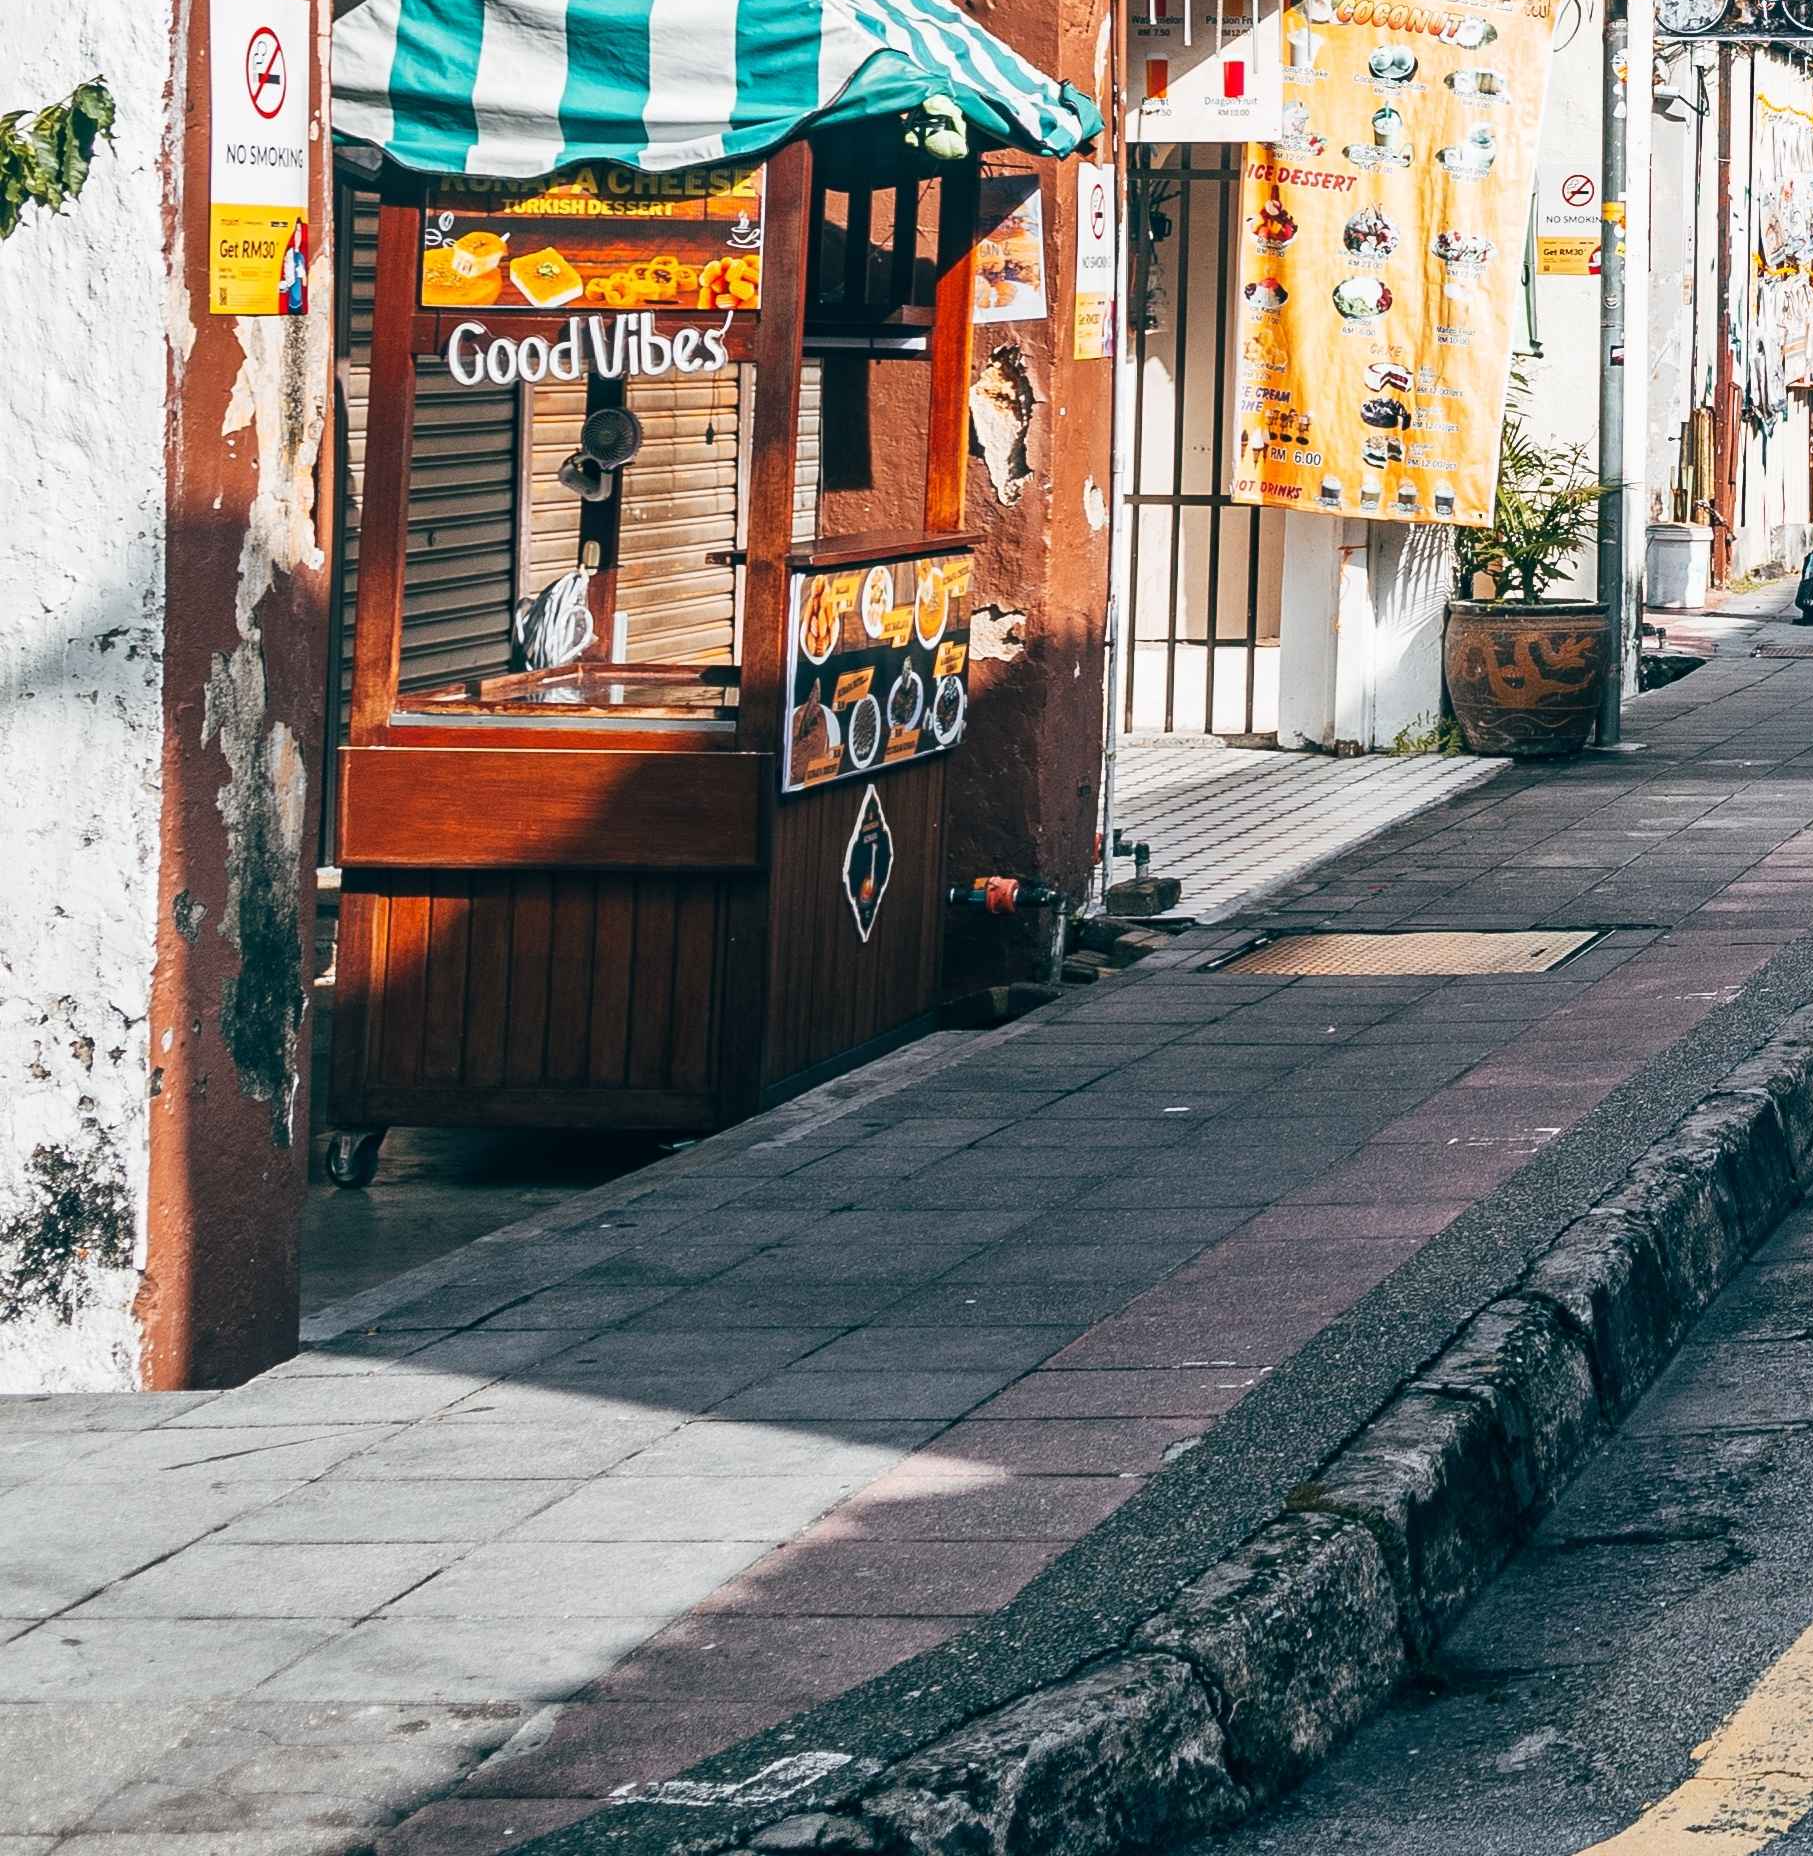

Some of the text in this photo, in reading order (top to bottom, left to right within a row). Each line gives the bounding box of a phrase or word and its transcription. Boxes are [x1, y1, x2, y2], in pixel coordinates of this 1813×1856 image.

[227, 145, 303, 168] NO SMOKING
[609, 167, 757, 197] CHEESE
[1248, 164, 1357, 192] ICE DESSERT
[502, 198, 674, 216] TURKISH DESSERT
[1546, 216, 1601, 224] NO SMOKIN
[220, 240, 238, 258] Get
[1543, 248, 1557, 256] Get
[449, 310, 735, 386] Good Vibes
[1256, 388, 1290, 403] CREAM
[1270, 447, 1322, 466] RM 6.00
[1260, 482, 1302, 500] DRINKS
